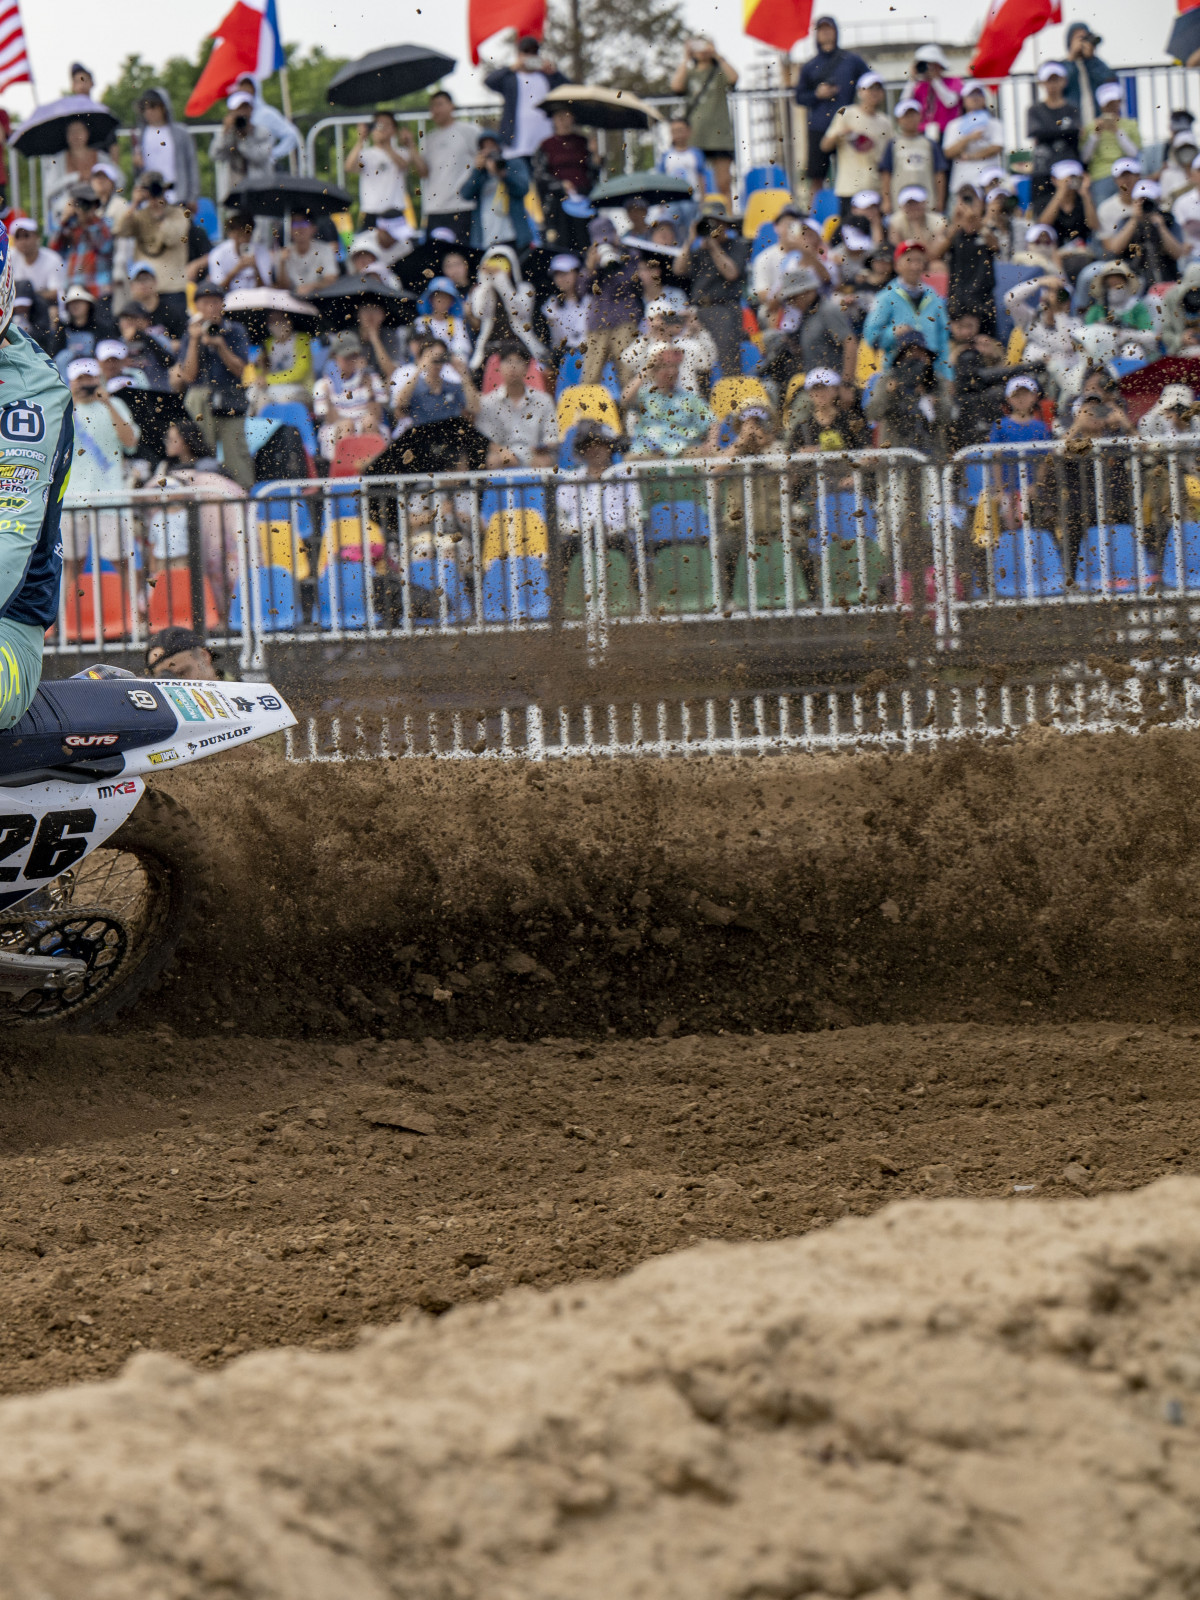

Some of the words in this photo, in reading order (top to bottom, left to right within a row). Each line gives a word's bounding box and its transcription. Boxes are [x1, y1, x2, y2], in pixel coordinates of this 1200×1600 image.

[6, 448, 46, 463] MOTOREX
[173, 689, 198, 719] MOTOREX
[65, 735, 119, 746] GUTS
[200, 726, 252, 748] DUNLOP
[97, 781, 136, 799] MX2
